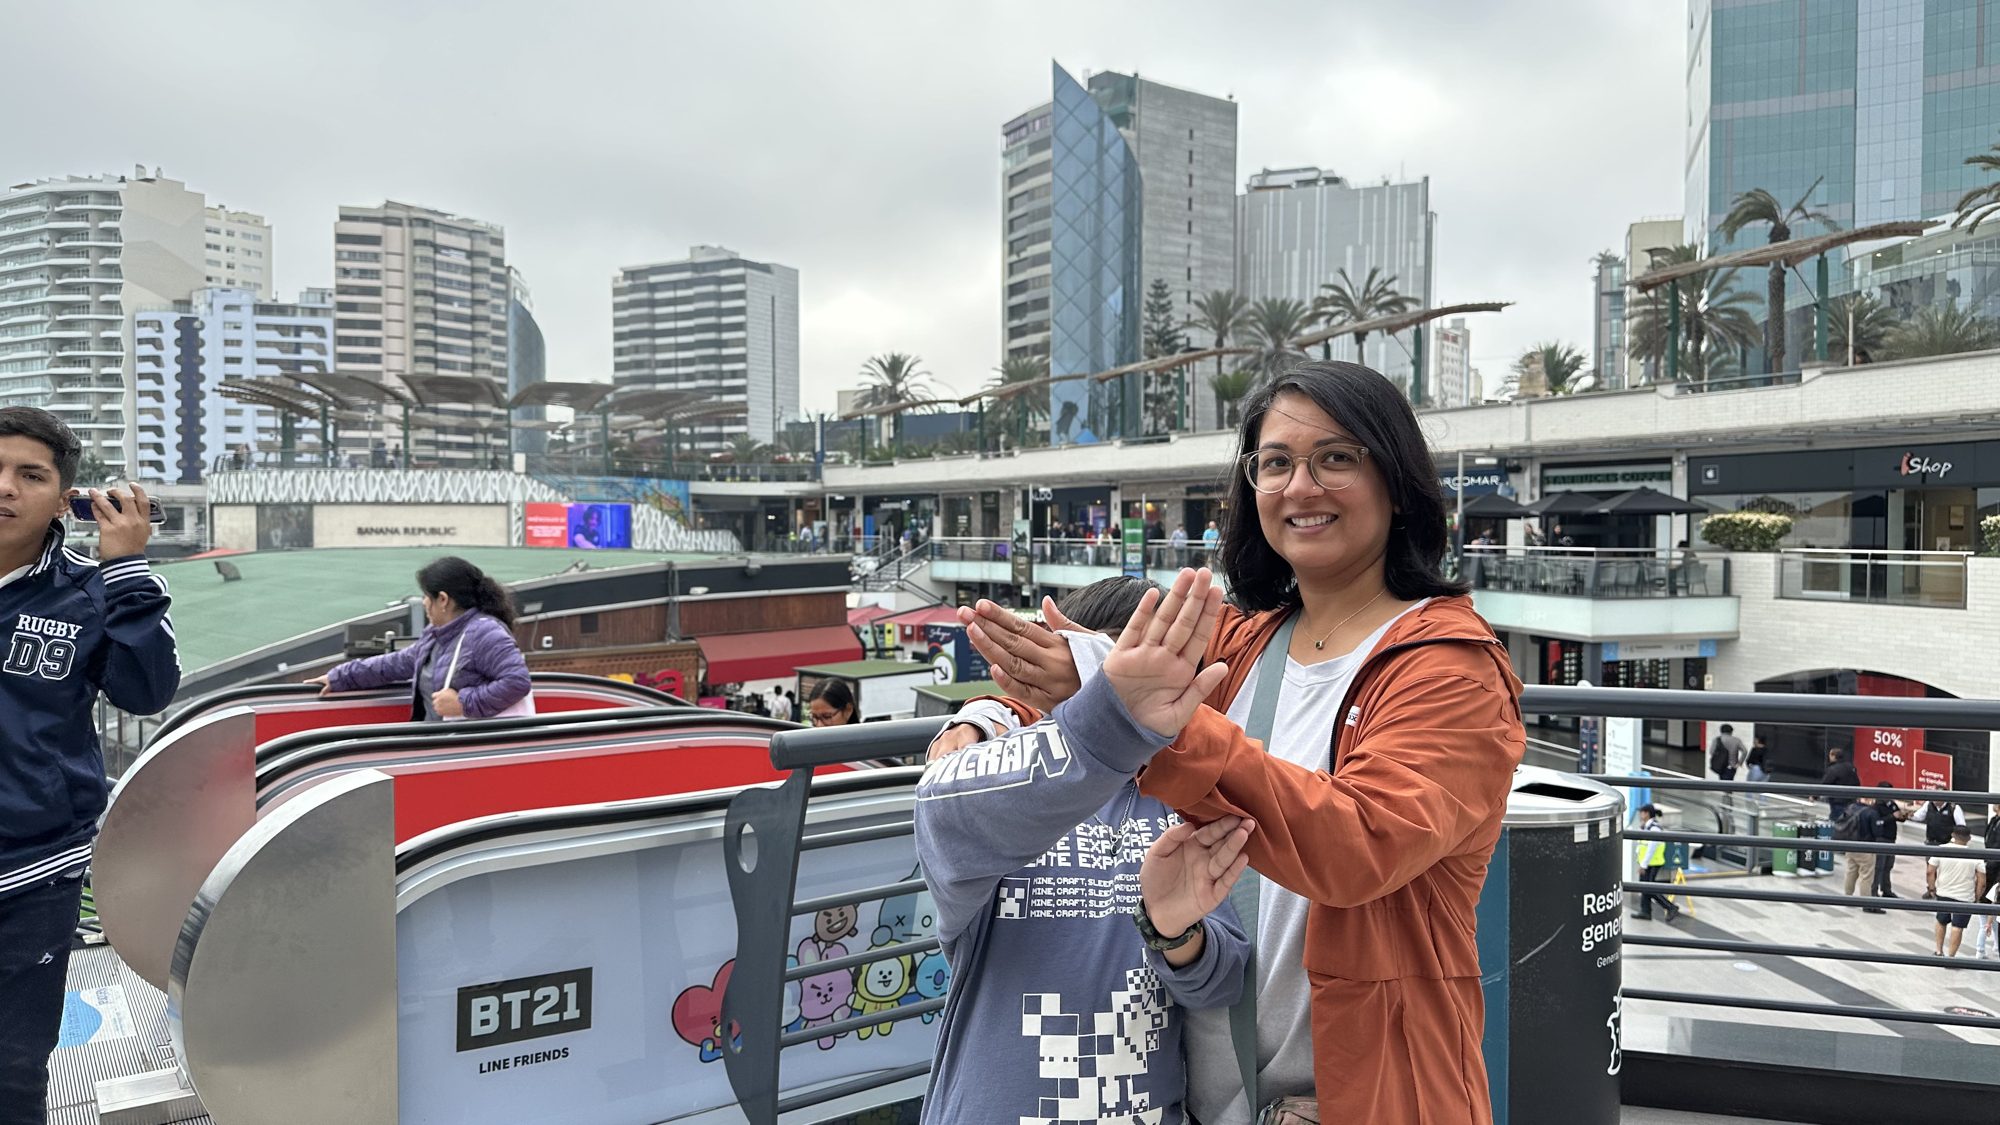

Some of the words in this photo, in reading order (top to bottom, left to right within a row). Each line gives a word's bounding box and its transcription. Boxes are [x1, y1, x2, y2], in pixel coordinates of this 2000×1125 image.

[1901, 452, 1953, 478] iShop
[356, 527, 400, 536] BANANA
[403, 527, 457, 536] REPUBLIC
[15, 614, 83, 640] RUGBY
[3, 631, 77, 681] D9
[1873, 730, 1903, 748] 50%
[1870, 748, 1905, 766] dcto.
[1077, 832, 1153, 854] EXPORE
[1032, 888, 1056, 897] MINE,
[1056, 888, 1088, 897] CRAFT,
[1056, 877, 1088, 887] CRAFT,
[1031, 899, 1056, 908] MINE,
[1056, 899, 1088, 908] CRAFT,
[1583, 881, 1622, 916] Resid
[1030, 910, 1055, 919] MINE,
[1055, 910, 1088, 919] CRAFT,
[1582, 915, 1622, 952] gener
[470, 981, 581, 1037] BT21
[479, 1058, 511, 1074] LINE
[513, 1047, 570, 1068] FRIENDS
